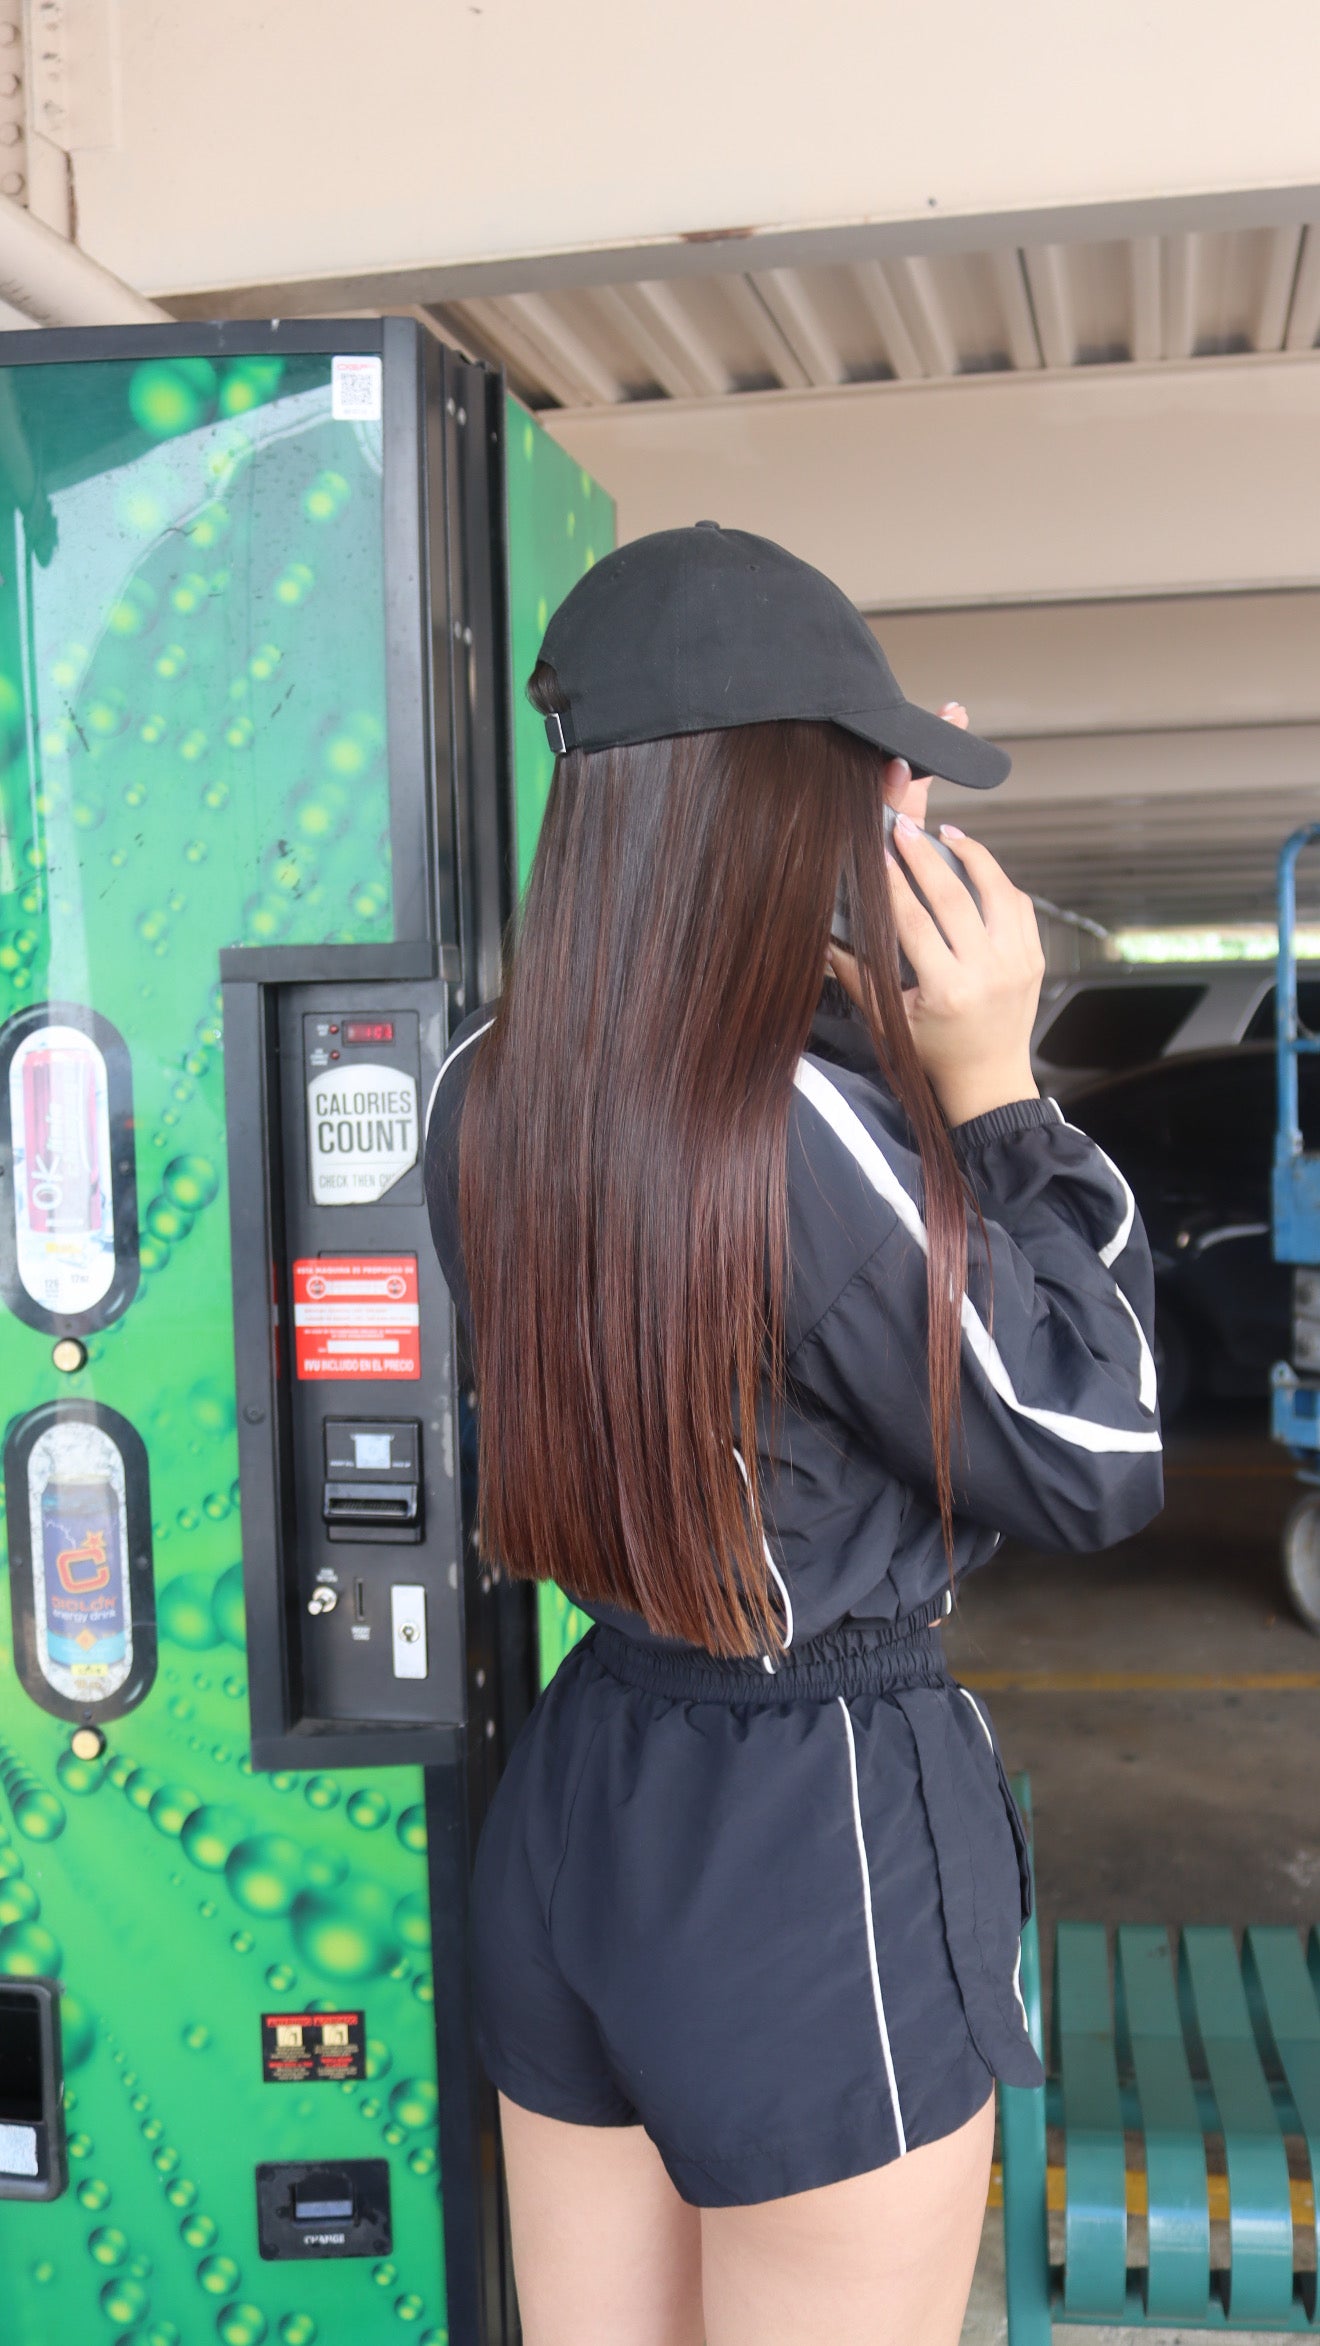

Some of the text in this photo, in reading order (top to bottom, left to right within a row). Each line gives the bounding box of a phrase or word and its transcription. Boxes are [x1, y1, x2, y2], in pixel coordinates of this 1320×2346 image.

[316, 1091, 412, 1117] CALORIES
[318, 1119, 412, 1154] COUNT
[319, 1174, 348, 1189] CHECK
[352, 1174, 376, 1188] THEN
[322, 1359, 359, 1371] INCLUIDO
[360, 1359, 371, 1371] EN
[372, 1359, 383, 1371] EL
[384, 1359, 414, 1372] PRECIO
[52, 1608, 116, 1623] energy drink
